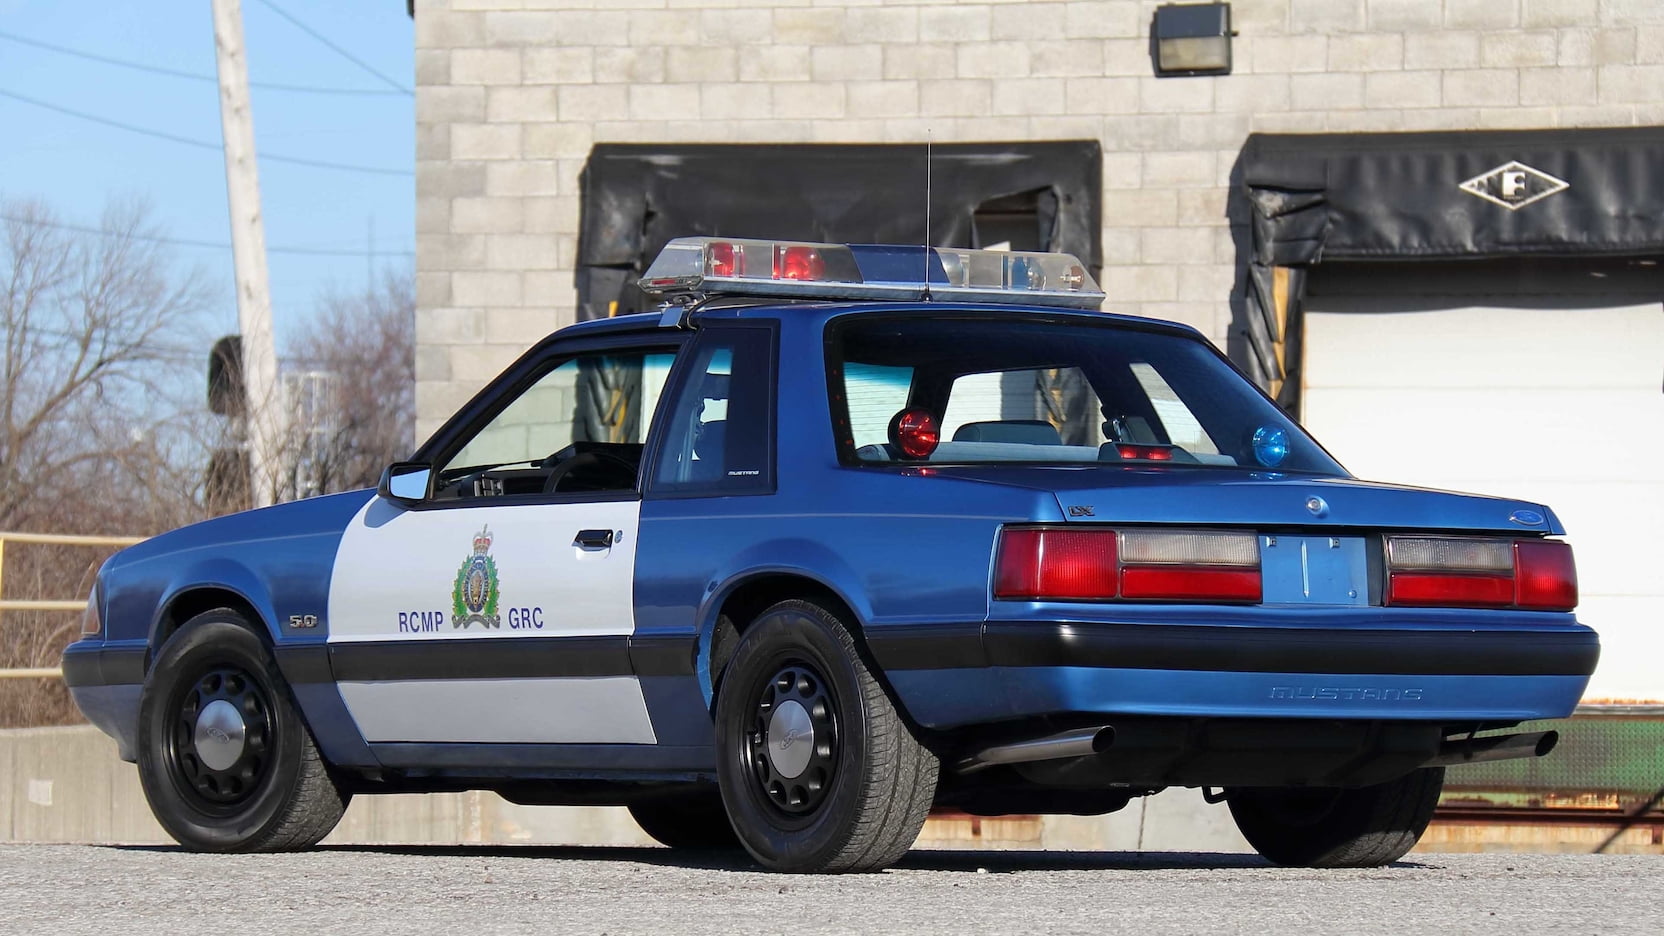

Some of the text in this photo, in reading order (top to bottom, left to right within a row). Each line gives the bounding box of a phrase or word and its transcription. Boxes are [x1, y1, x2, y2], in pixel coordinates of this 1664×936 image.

[1068, 505, 1096, 517] LX
[399, 607, 544, 633] RCMP GRC
